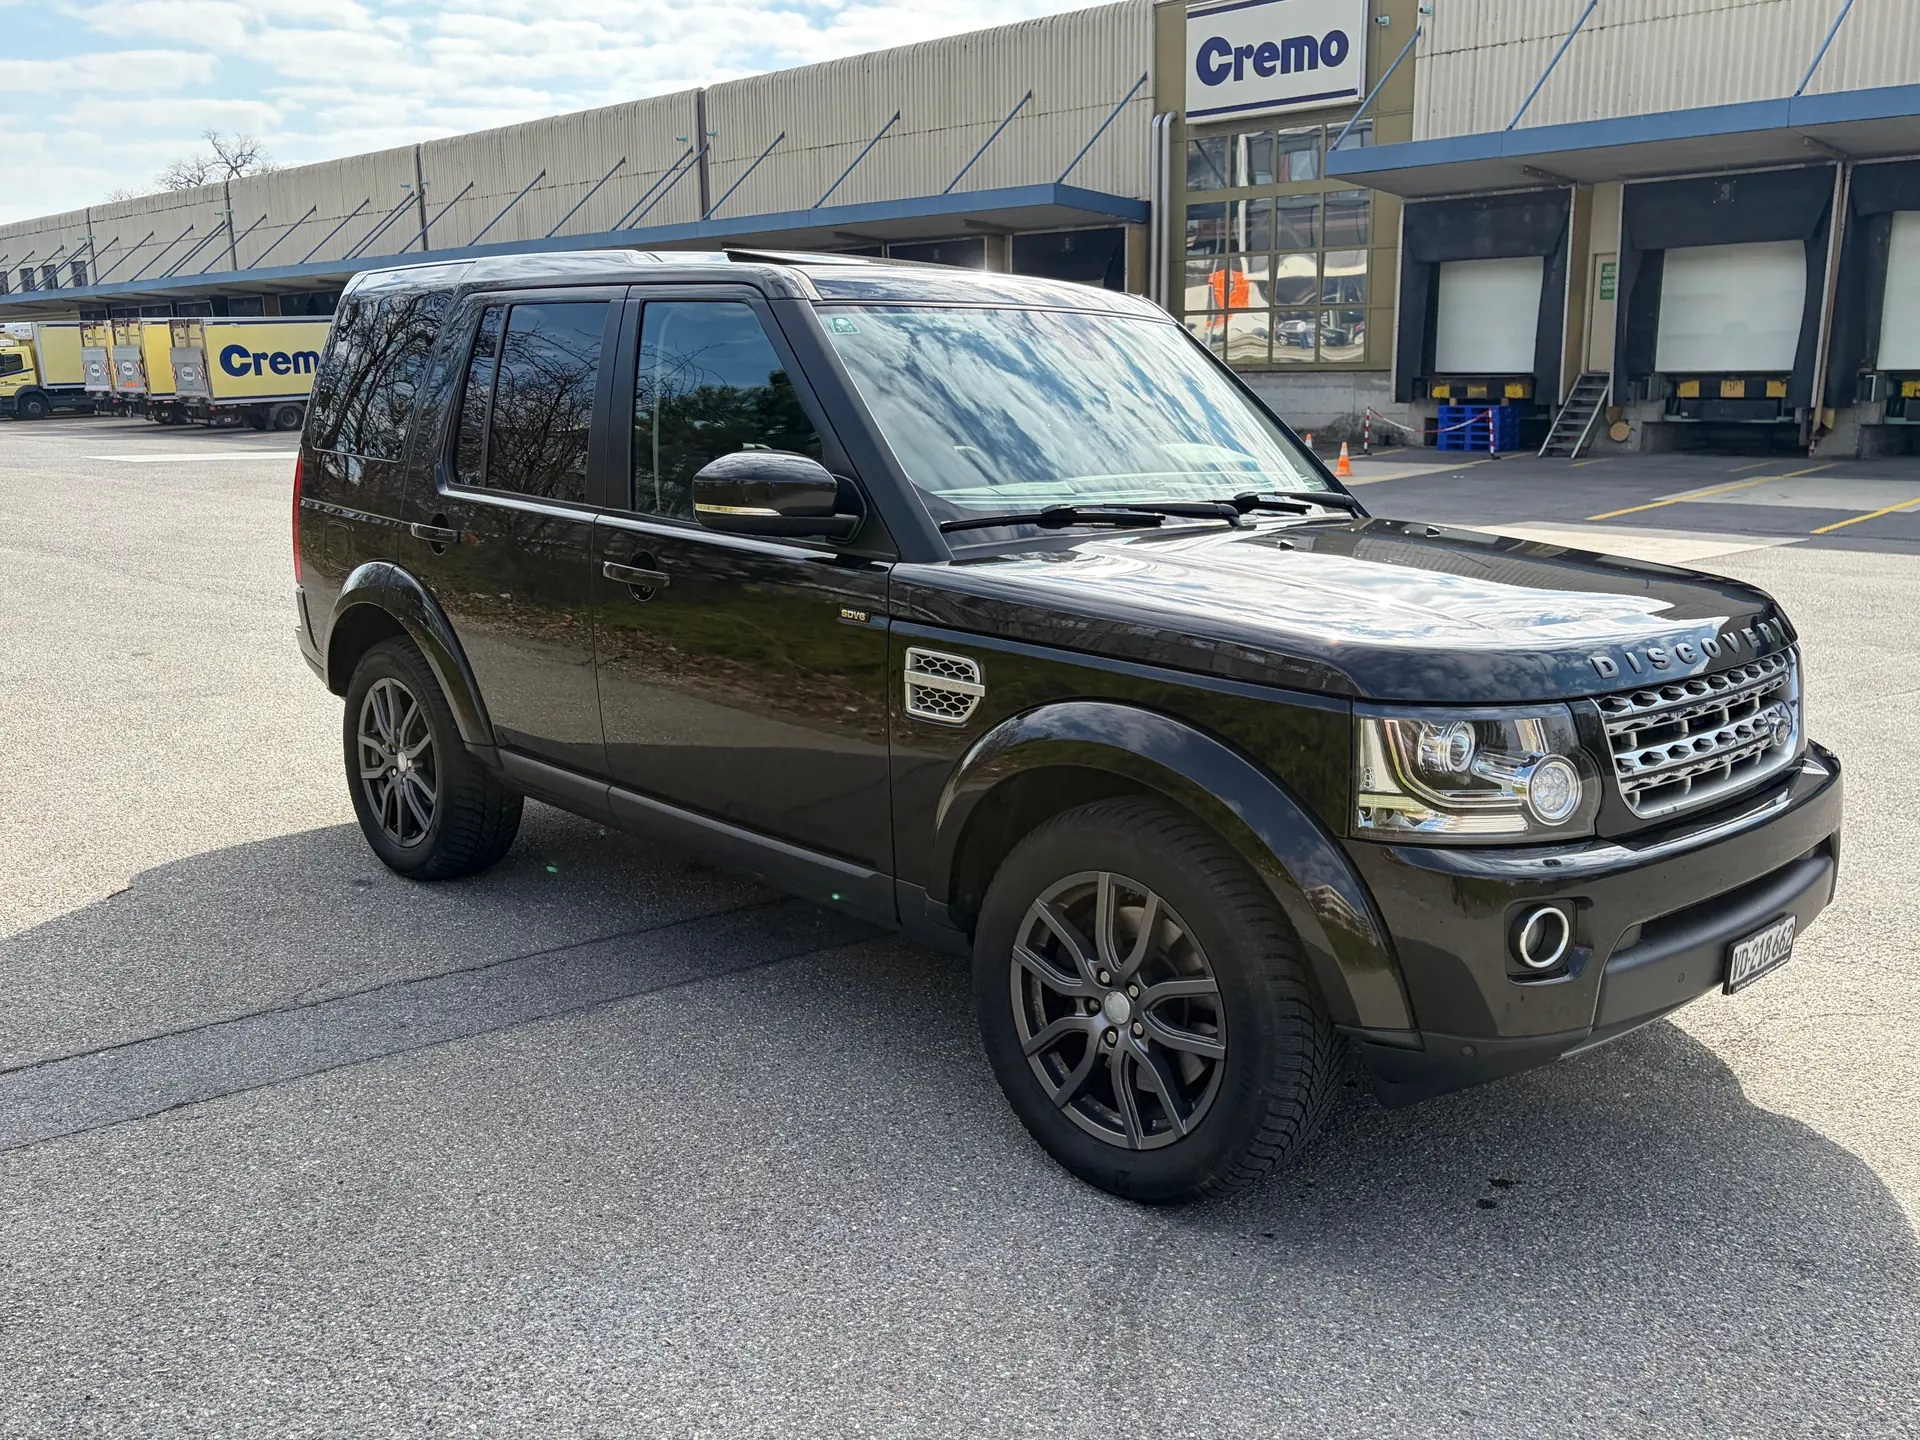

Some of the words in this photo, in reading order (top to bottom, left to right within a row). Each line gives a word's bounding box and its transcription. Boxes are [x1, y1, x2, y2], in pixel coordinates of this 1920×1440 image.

[1196, 30, 1349, 86] Cremo
[219, 344, 320, 377] Crem
[841, 609, 866, 621] SDV6
[1590, 616, 1791, 680] DISCOVERY
